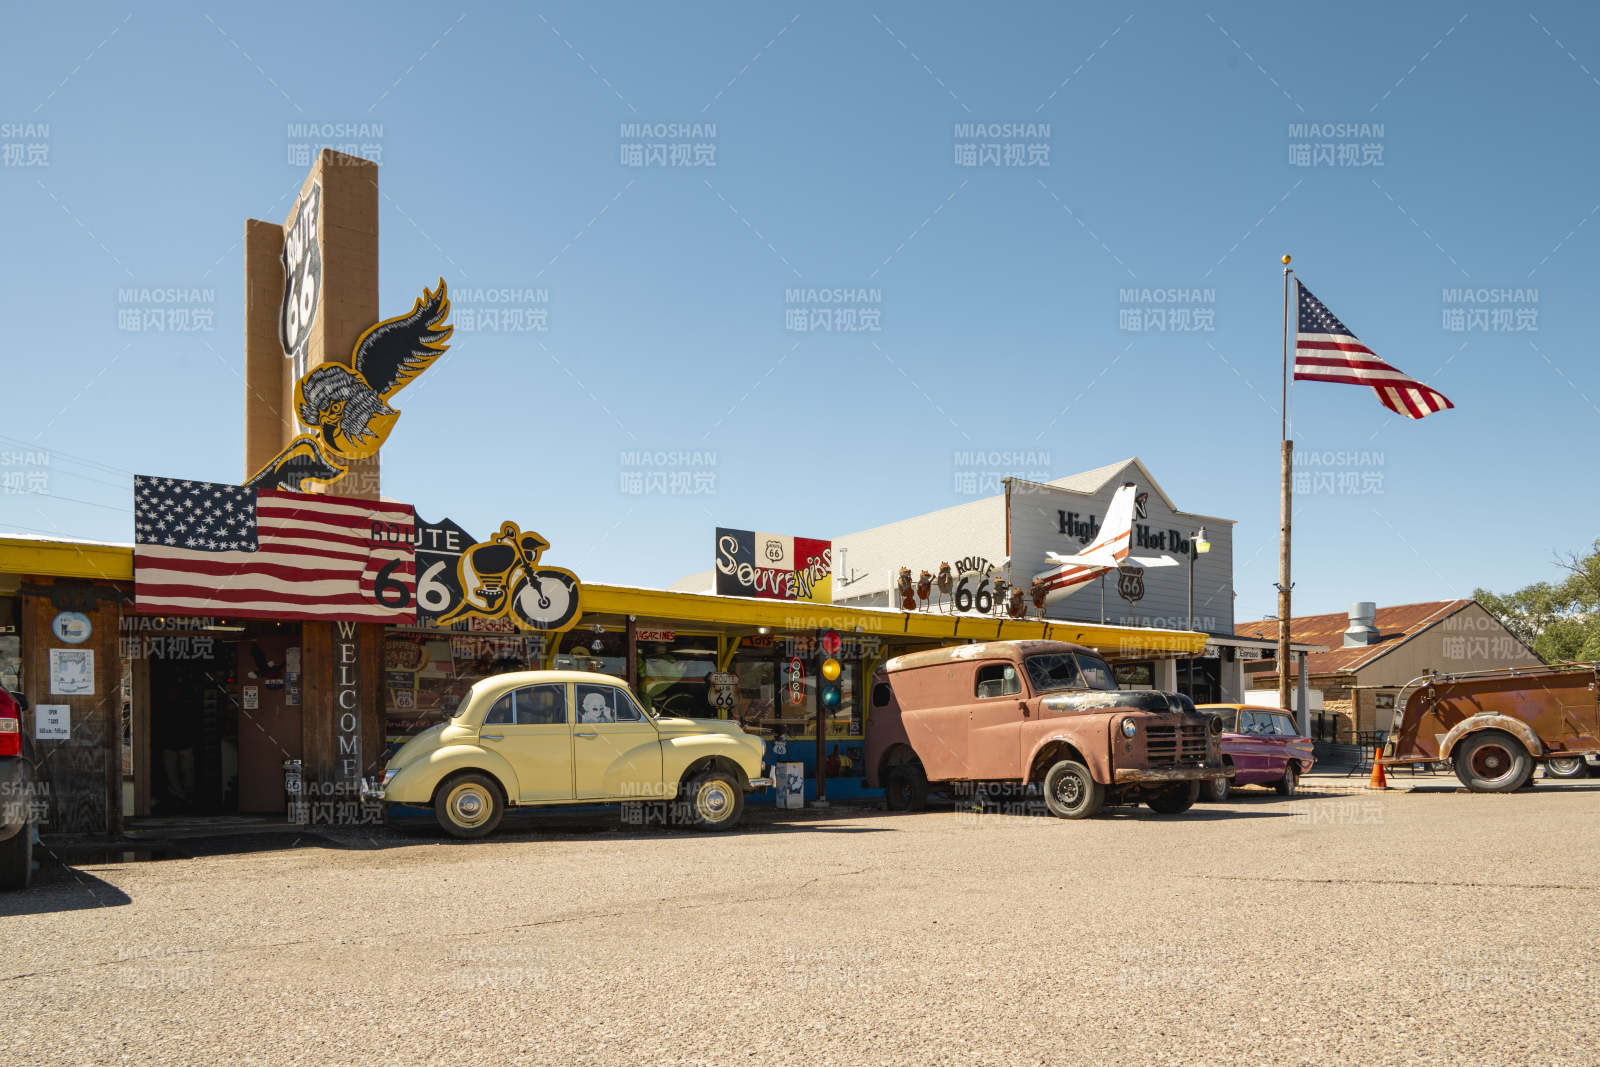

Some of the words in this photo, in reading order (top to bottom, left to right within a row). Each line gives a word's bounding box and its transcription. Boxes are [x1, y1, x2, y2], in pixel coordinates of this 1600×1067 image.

[286, 192, 316, 280] ROUTE
[286, 251, 314, 349] 66
[371, 521, 461, 550] ROUTE
[1136, 523, 1167, 550] Hot
[769, 549, 780, 558] 66
[955, 556, 995, 578] ROUTE
[374, 558, 451, 612] 66
[955, 577, 993, 614] 66
[1122, 576, 1140, 593] 66
[336, 620, 359, 778] WELCOME
[716, 693, 734, 706] 66
